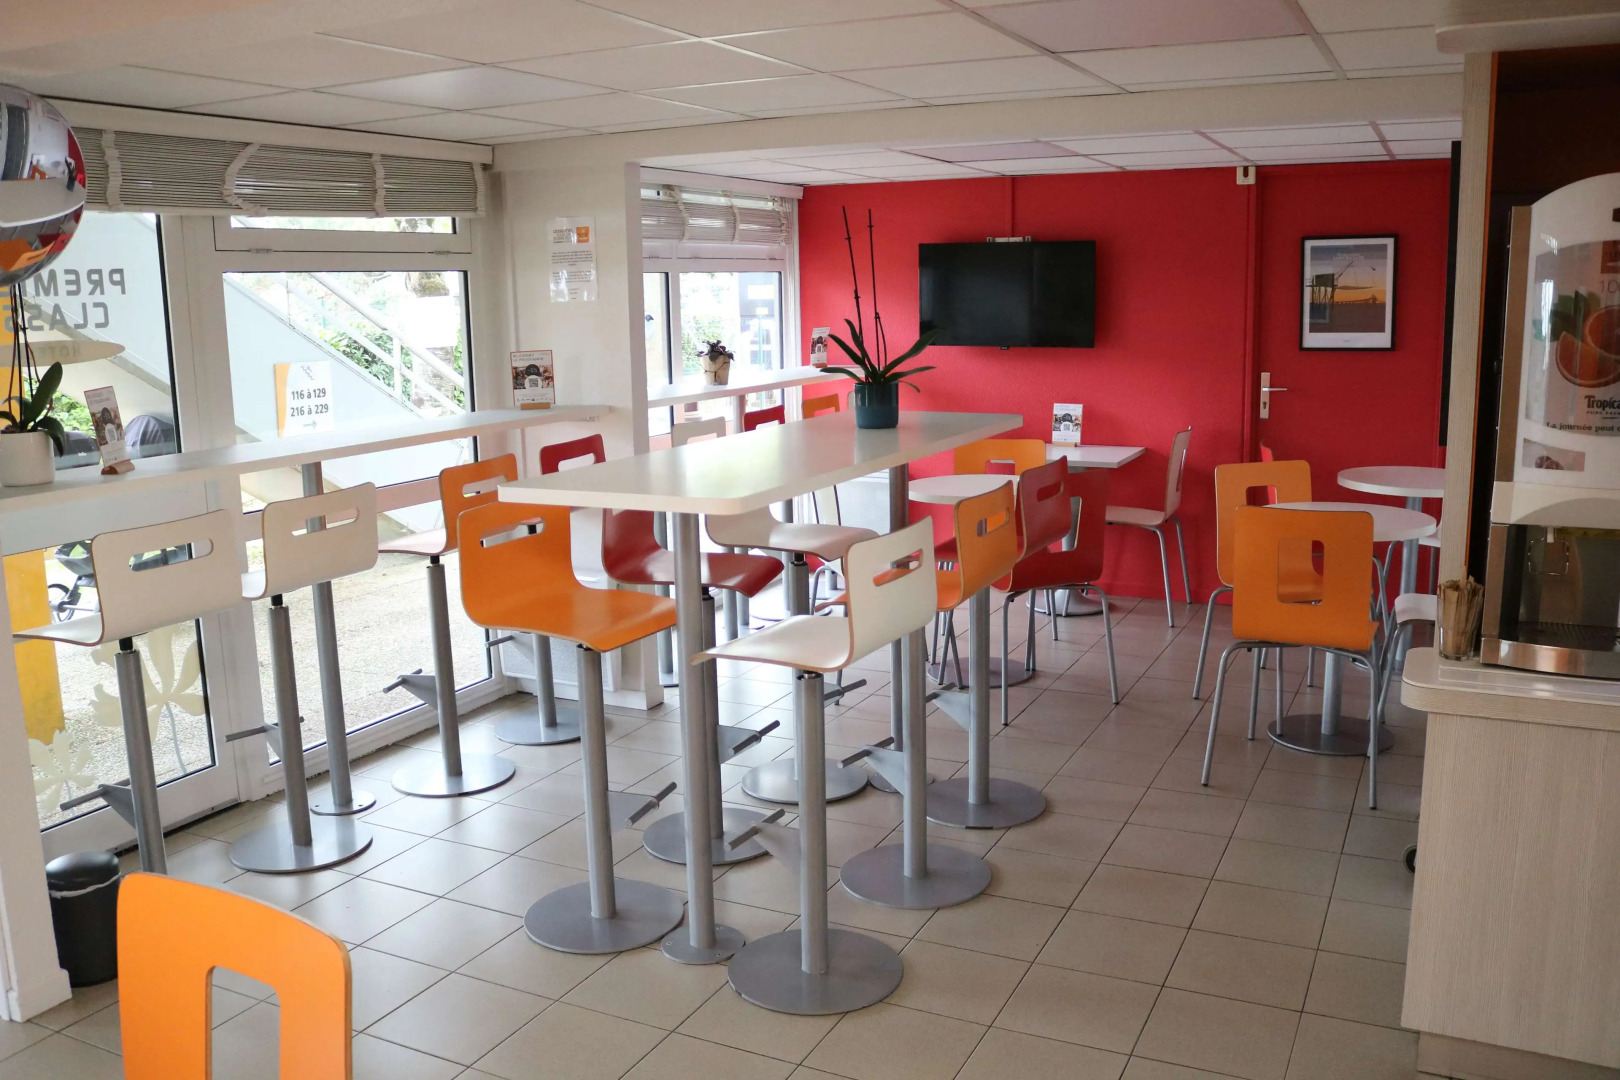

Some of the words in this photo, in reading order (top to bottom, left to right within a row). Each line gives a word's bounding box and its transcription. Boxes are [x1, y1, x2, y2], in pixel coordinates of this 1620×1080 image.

[291, 390, 304, 400] 116
[306, 389, 312, 399] à
[313, 388, 326, 398] 129
[290, 406, 304, 416] 216
[308, 405, 312, 415] à
[314, 404, 328, 414] 229
